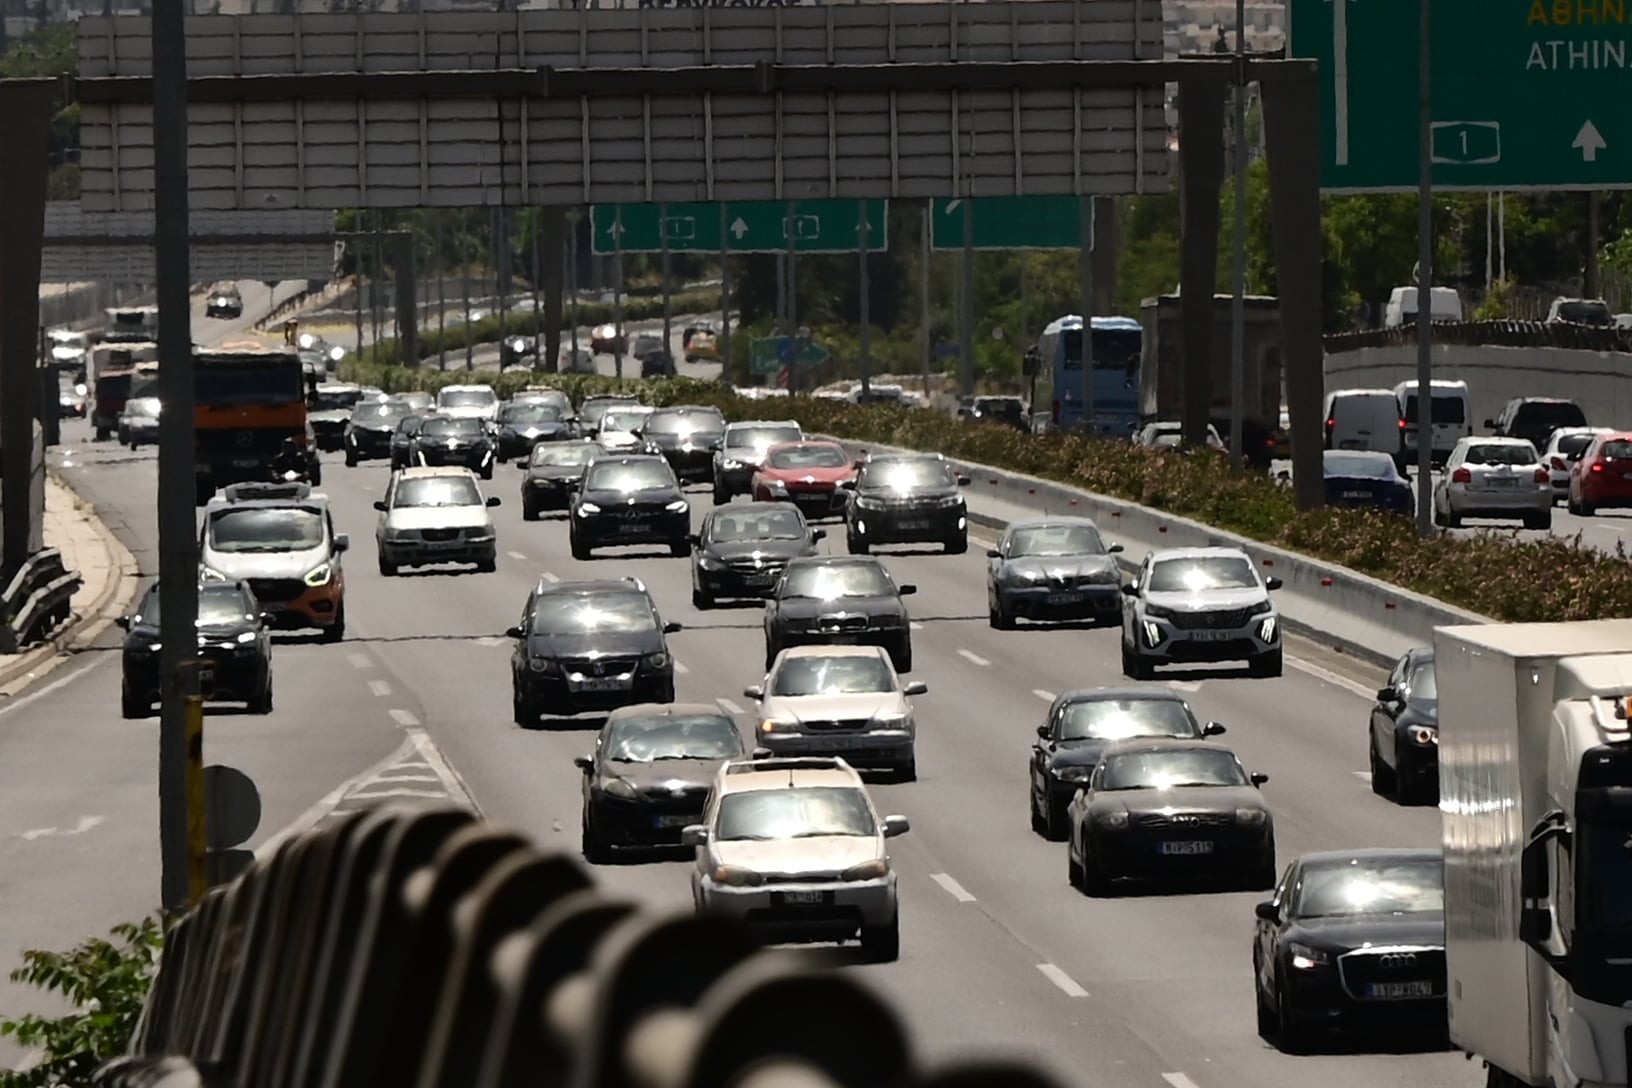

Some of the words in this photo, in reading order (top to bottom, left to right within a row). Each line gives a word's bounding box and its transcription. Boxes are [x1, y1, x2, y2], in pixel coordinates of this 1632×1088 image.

[1526, 0, 1632, 27] ΑΘΗΝ
[1525, 40, 1632, 70] ATHIN
[1459, 130, 1468, 155] 1
